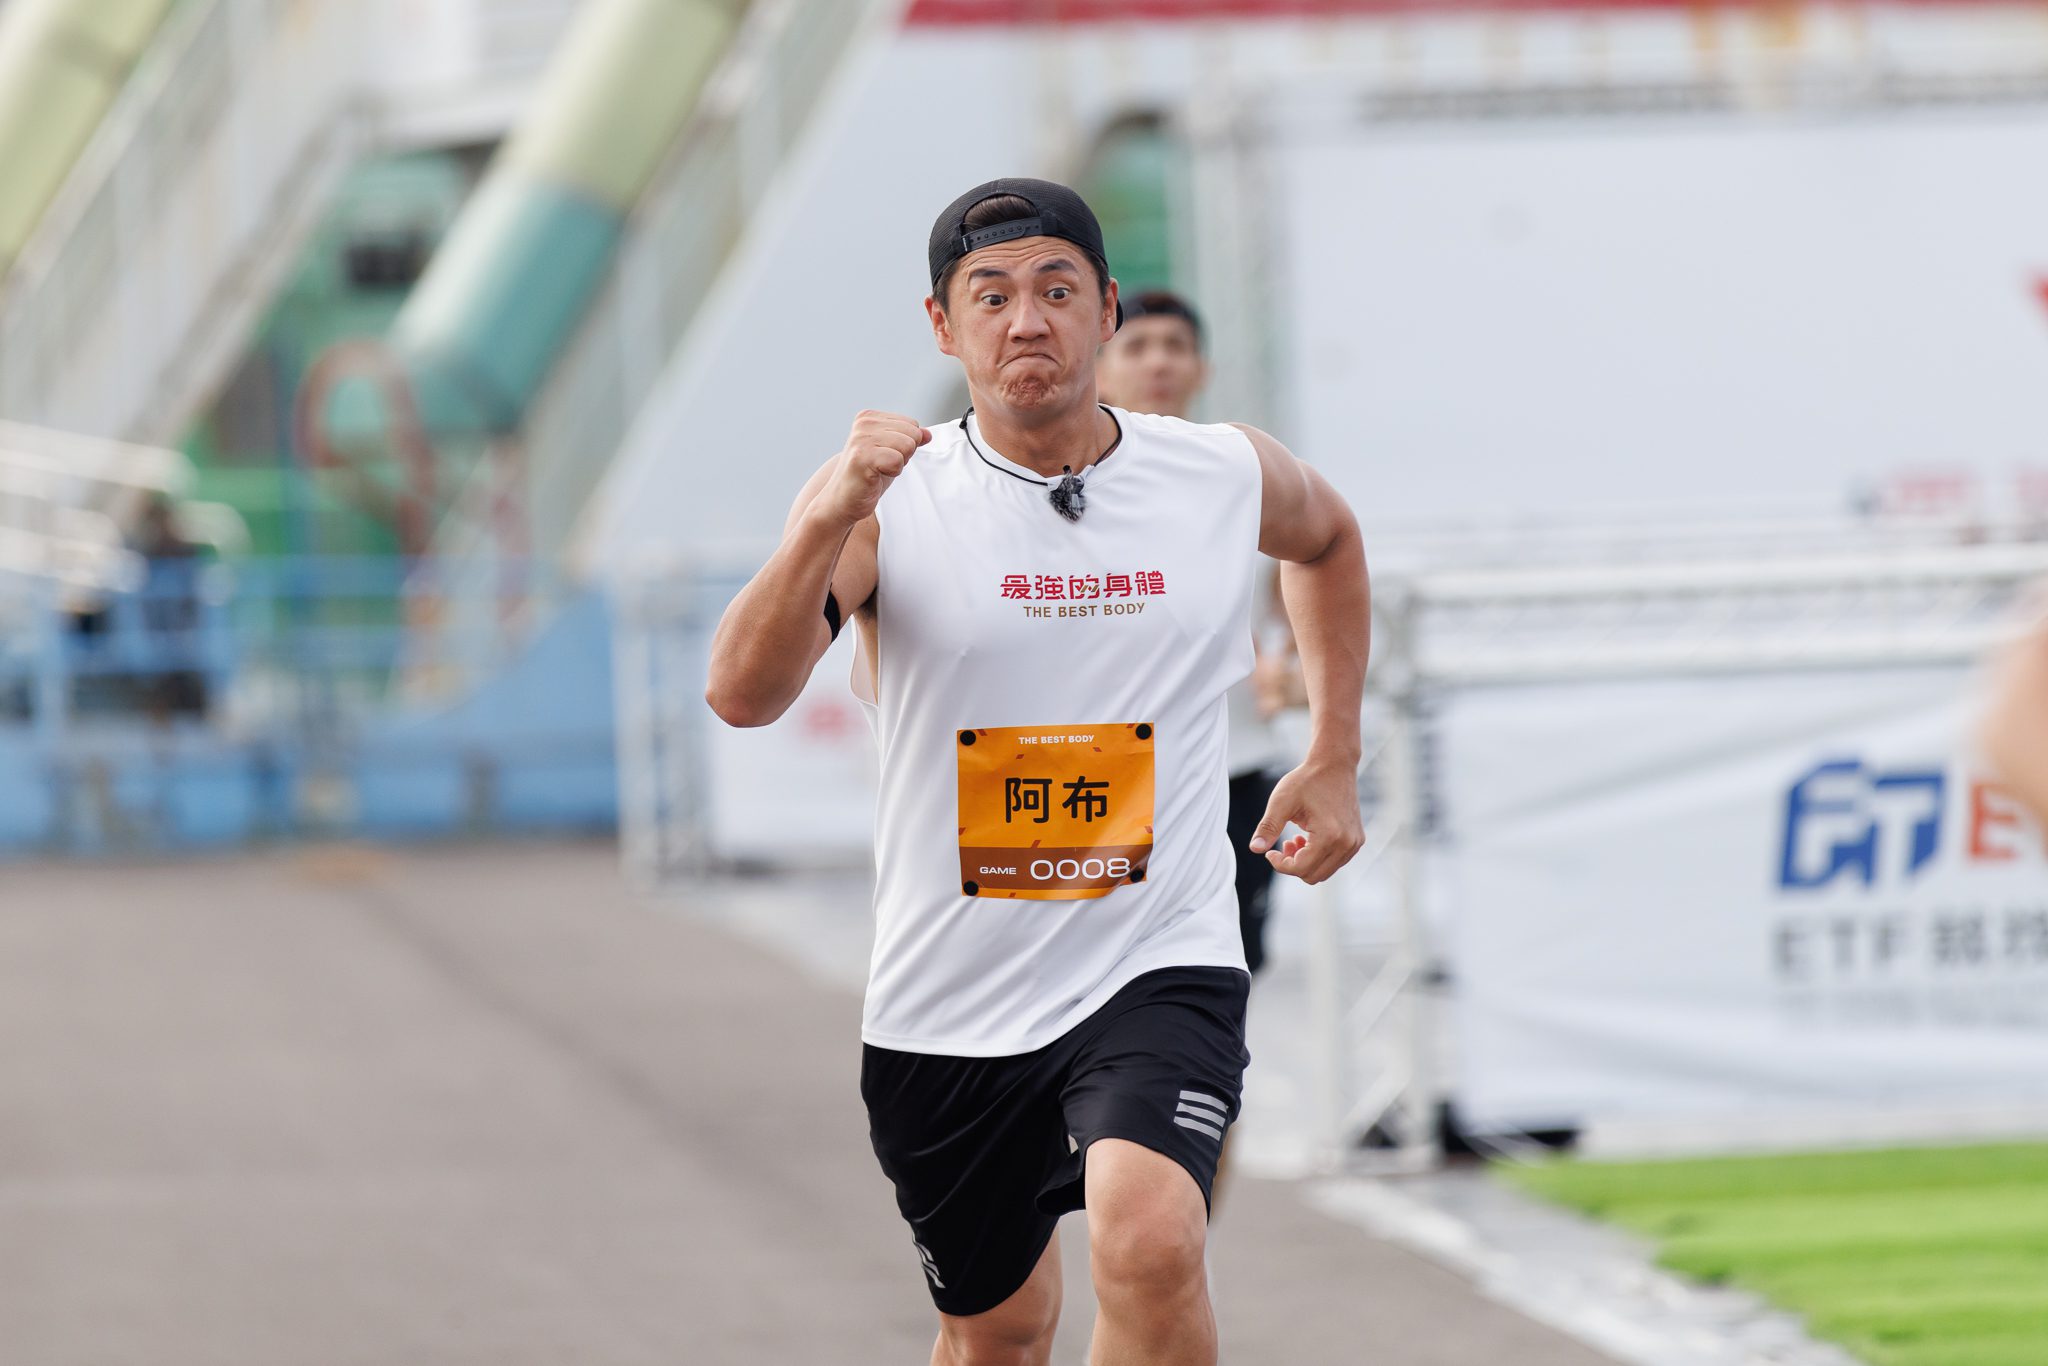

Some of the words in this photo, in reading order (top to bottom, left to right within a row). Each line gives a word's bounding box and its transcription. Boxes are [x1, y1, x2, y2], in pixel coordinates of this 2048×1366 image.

[1000, 570, 1167, 600] 最強的身體
[1023, 606, 1052, 618] THE
[1058, 605, 1098, 618] BEST
[1103, 602, 1145, 616] BODY
[1018, 736, 1038, 745] THE
[1040, 735, 1066, 744] BEST
[1068, 734, 1095, 743] BODY
[1004, 775, 1110, 824] 阿布
[979, 866, 1017, 875] GAME
[1030, 857, 1131, 881] 0008
